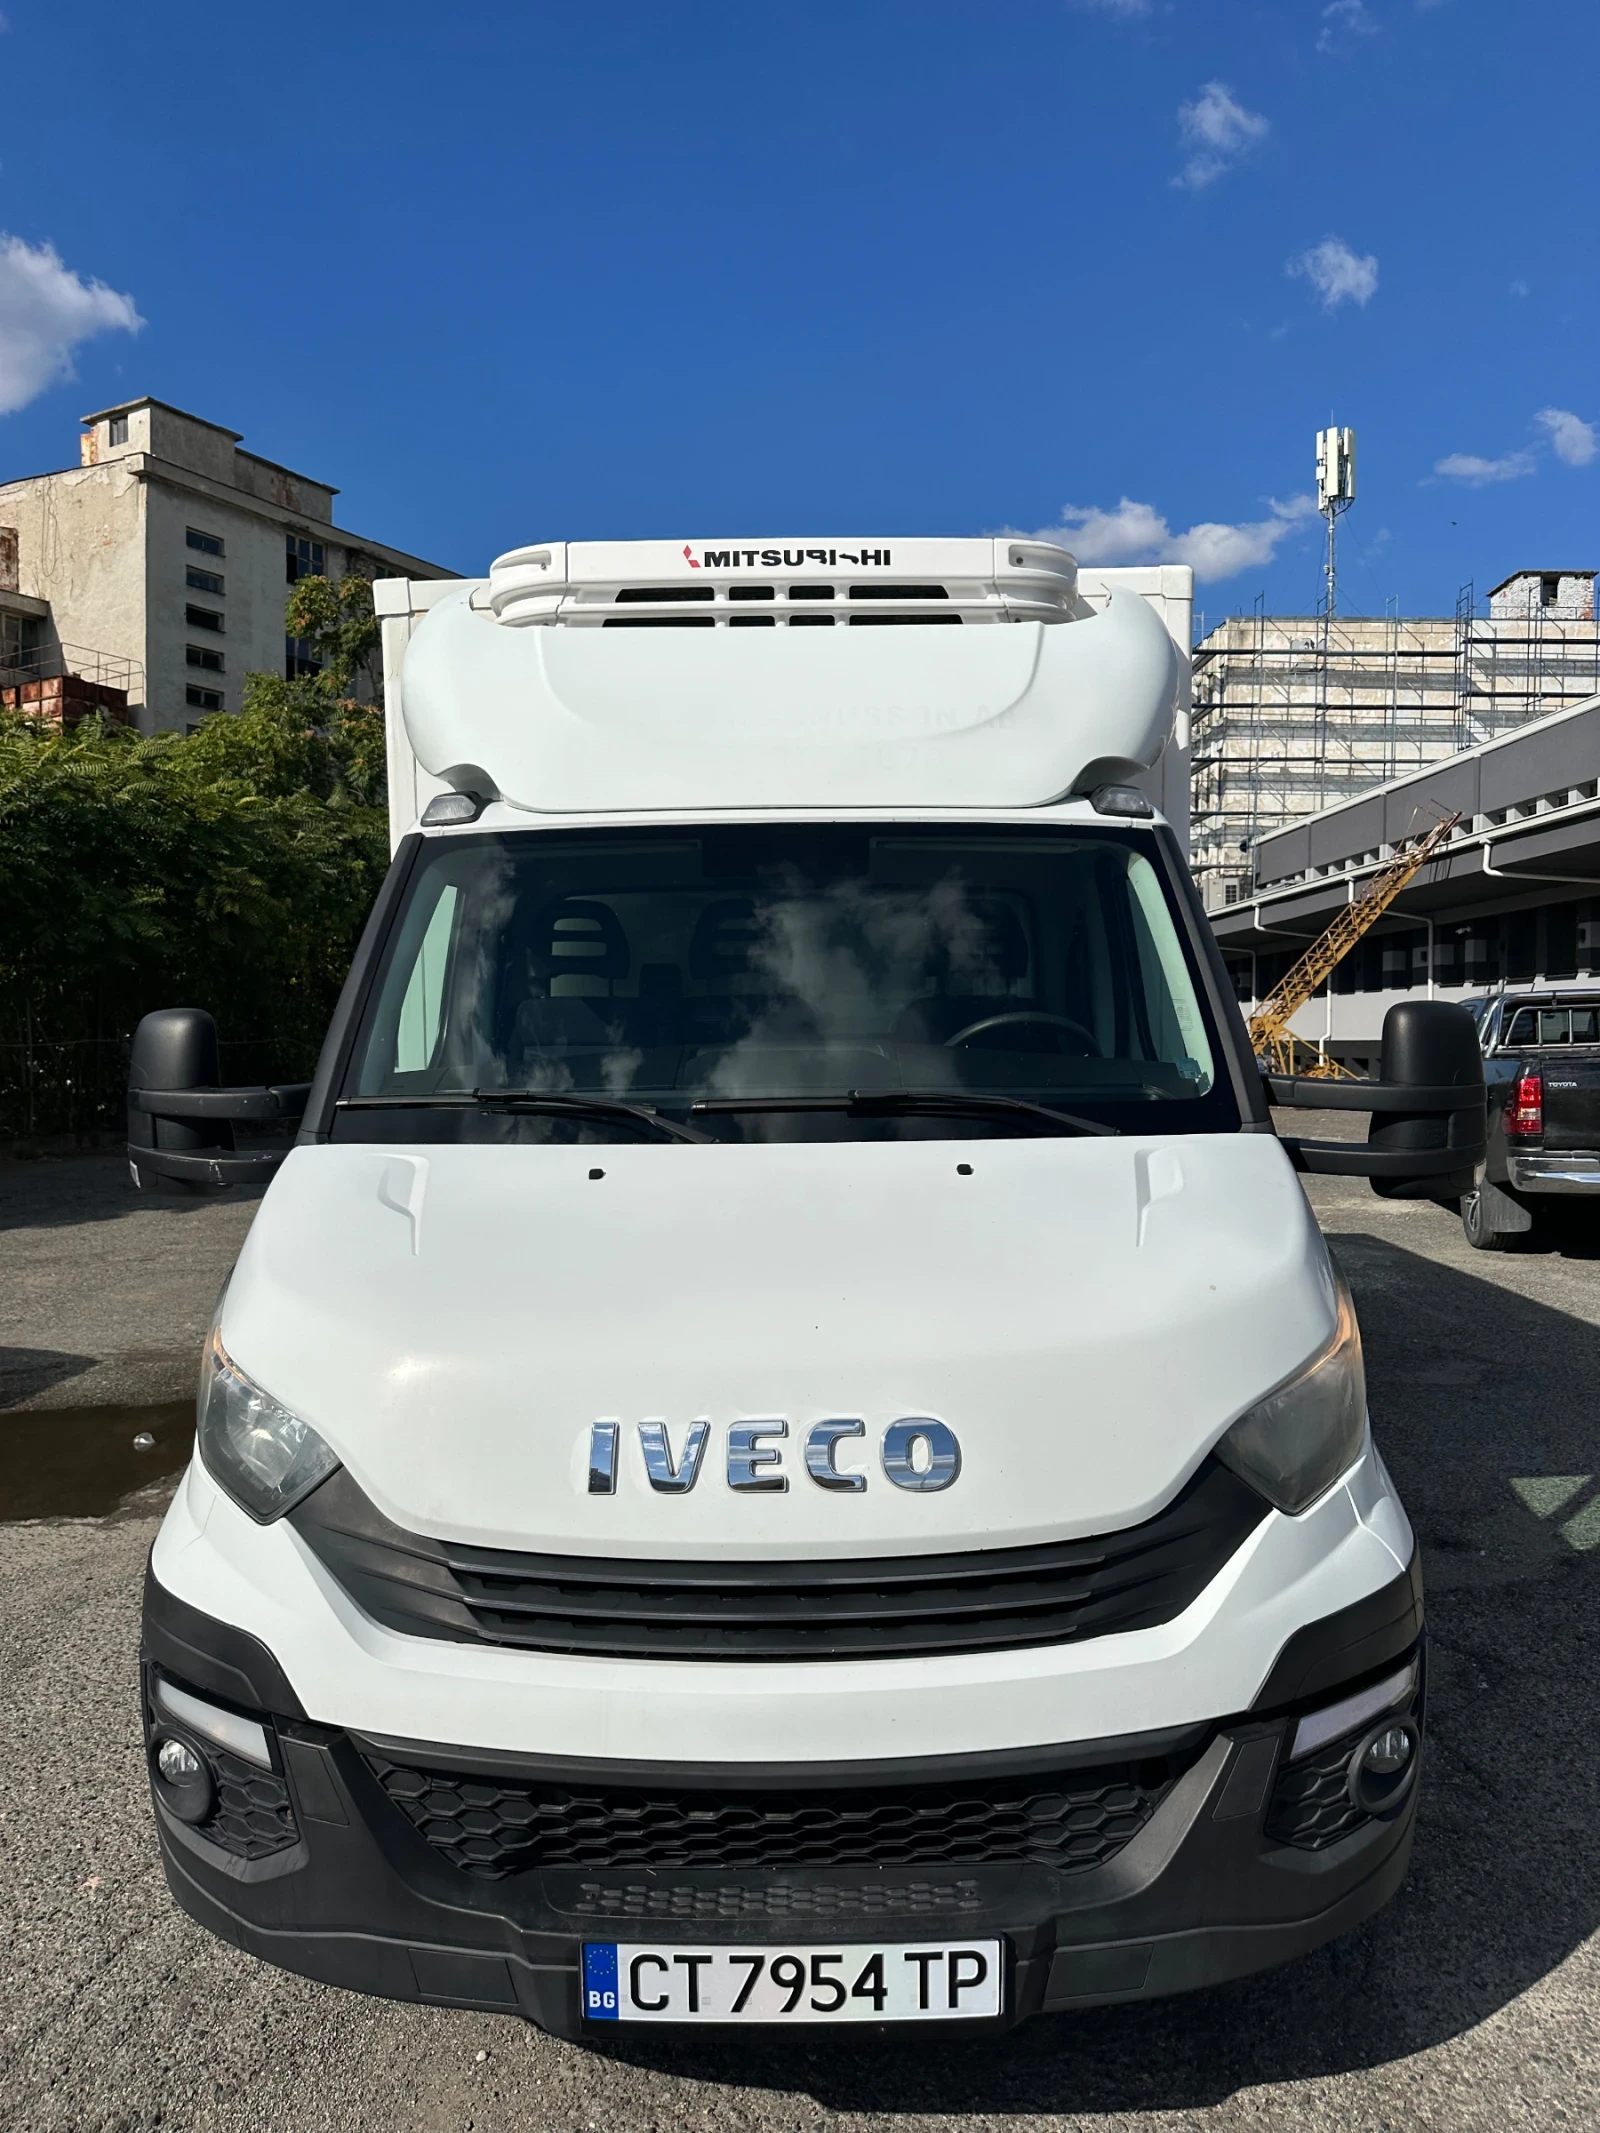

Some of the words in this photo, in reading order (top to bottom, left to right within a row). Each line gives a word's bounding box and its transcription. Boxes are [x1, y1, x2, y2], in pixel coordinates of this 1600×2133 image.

[587, 1417, 962, 1494] IVECO
[589, 1991, 615, 2009] BG
[629, 1954, 713, 2013] CT
[729, 1954, 888, 2013] 7954
[903, 1950, 987, 2010] TP
